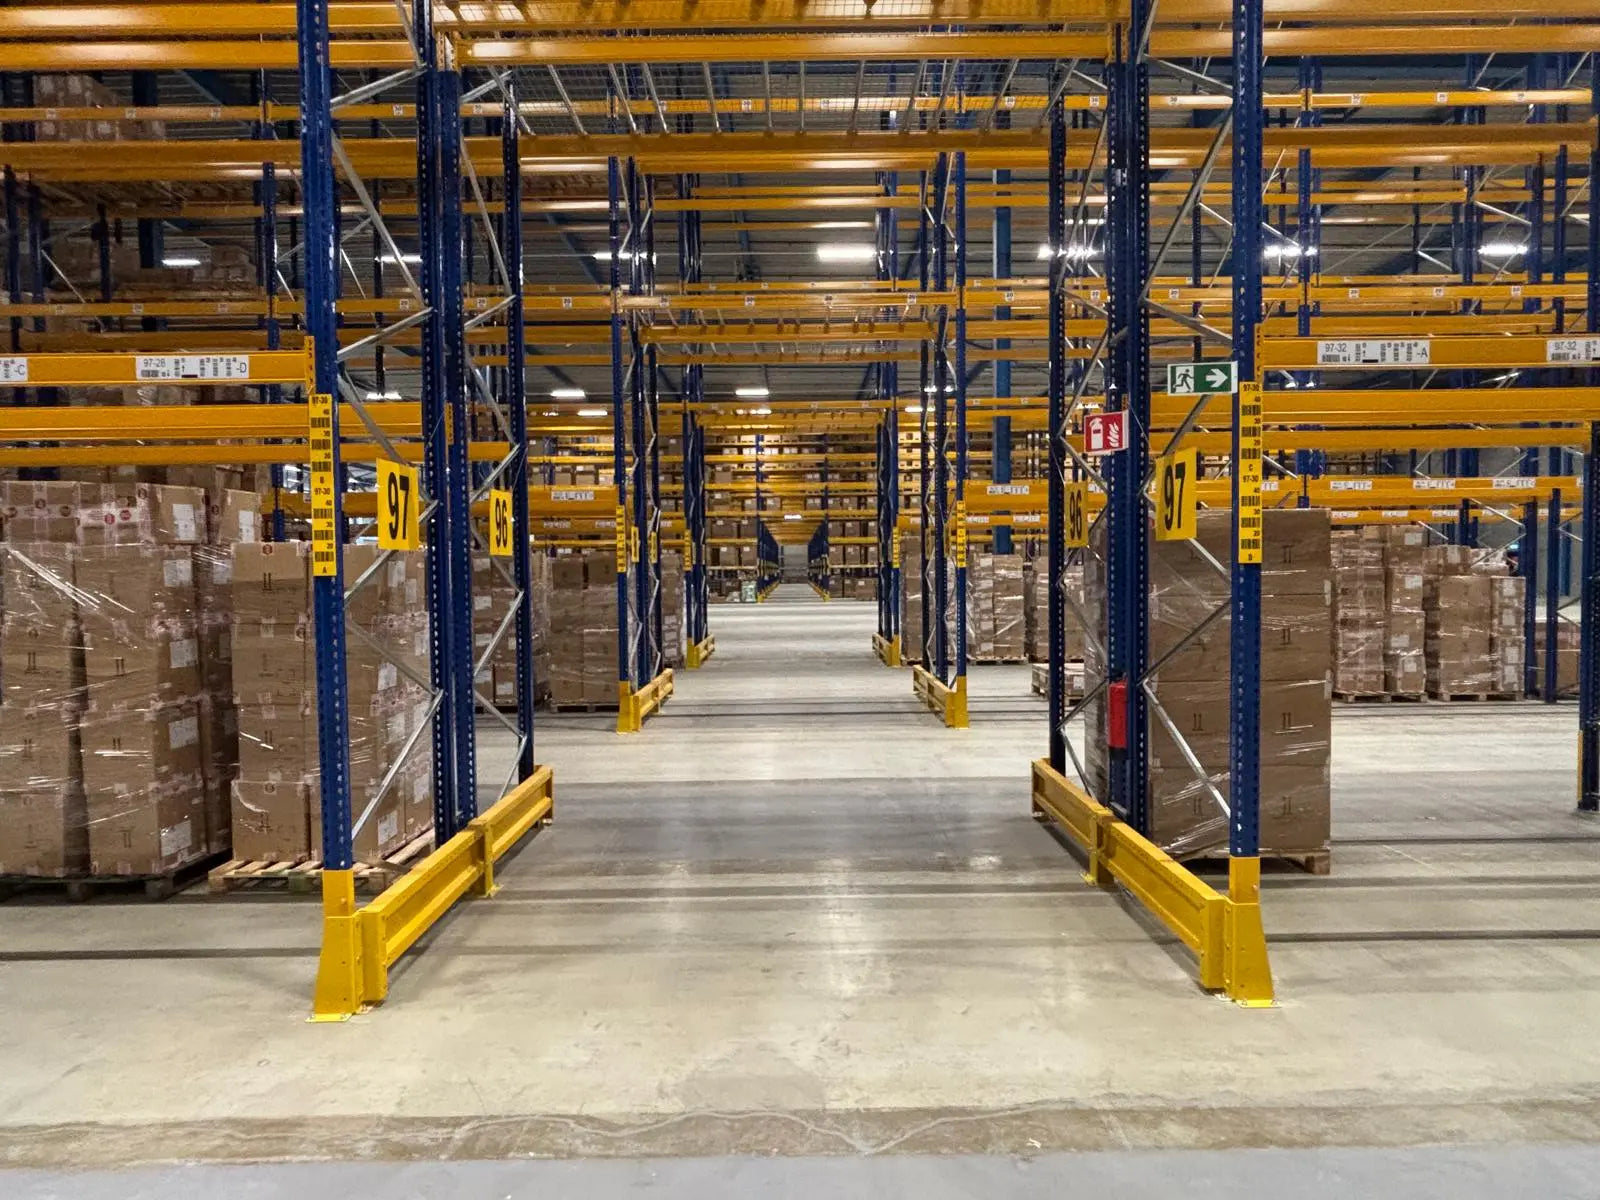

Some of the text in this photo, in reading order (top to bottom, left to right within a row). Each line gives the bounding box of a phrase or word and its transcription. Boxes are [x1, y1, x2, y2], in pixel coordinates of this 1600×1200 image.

[1325, 342, 1347, 353] 97-32
[388, 471, 410, 540] 97
[1069, 489, 1082, 540] 96
[1164, 461, 1186, 531] 97
[495, 497, 508, 548] 96
